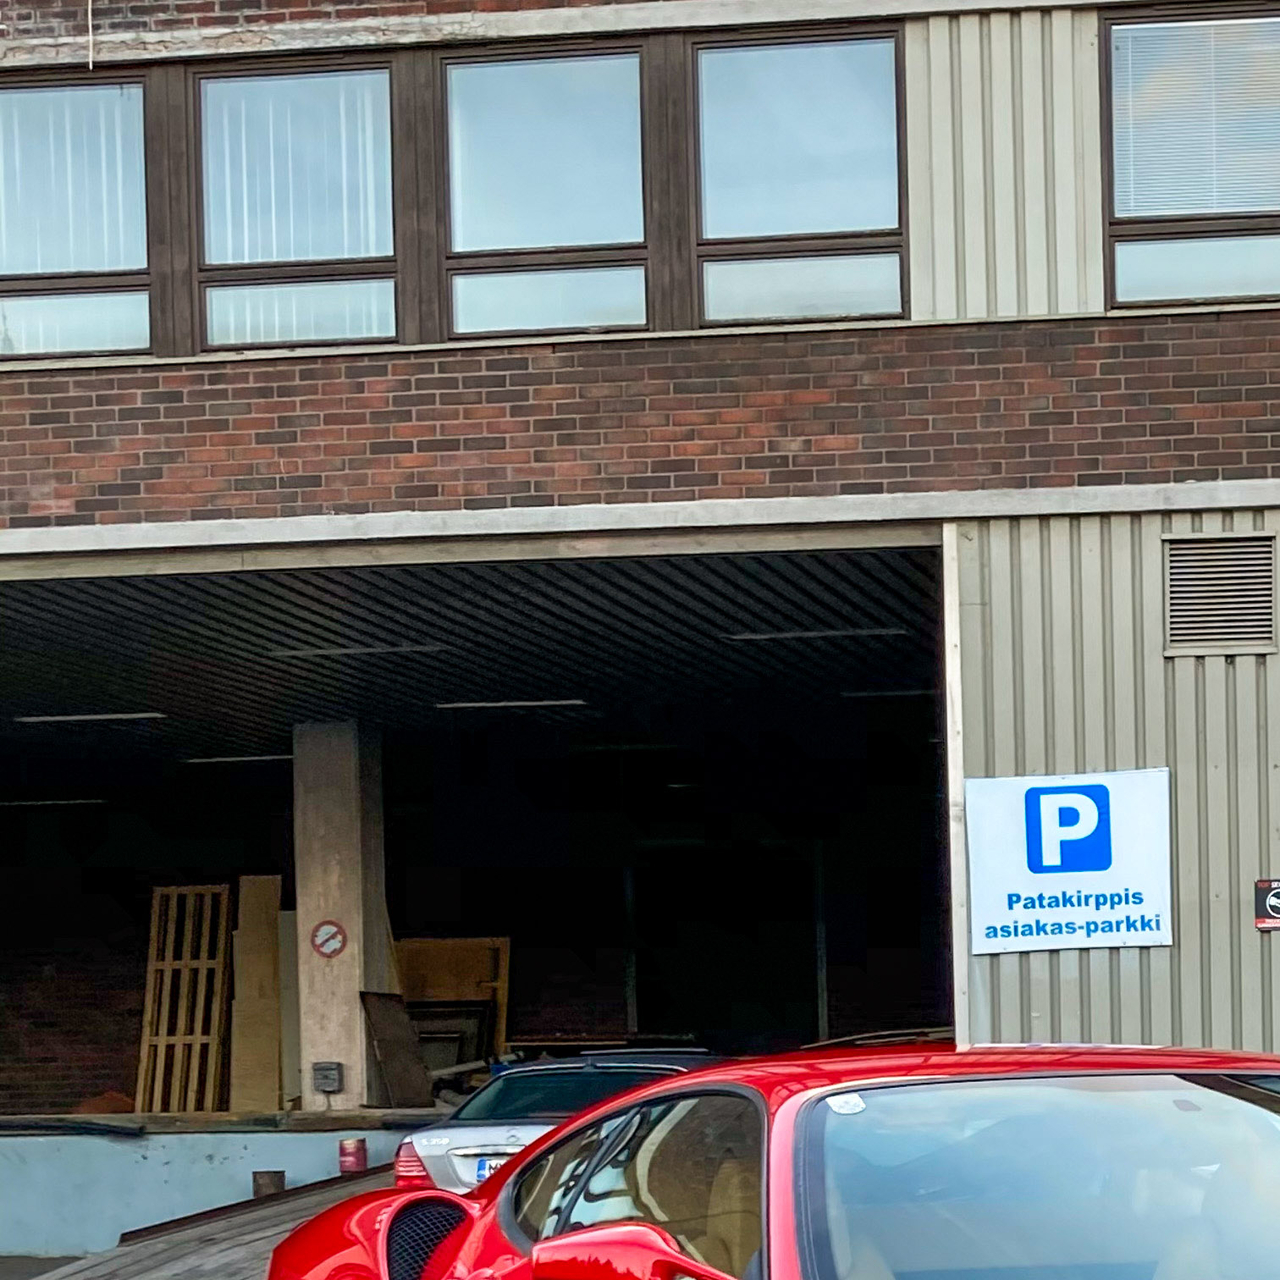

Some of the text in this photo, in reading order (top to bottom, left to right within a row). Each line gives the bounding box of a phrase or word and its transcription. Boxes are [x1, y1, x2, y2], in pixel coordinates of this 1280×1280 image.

[1039, 793, 1098, 866] P
[1007, 888, 1144, 911] Patakirppis
[985, 914, 1161, 939] asiakas-parkki
